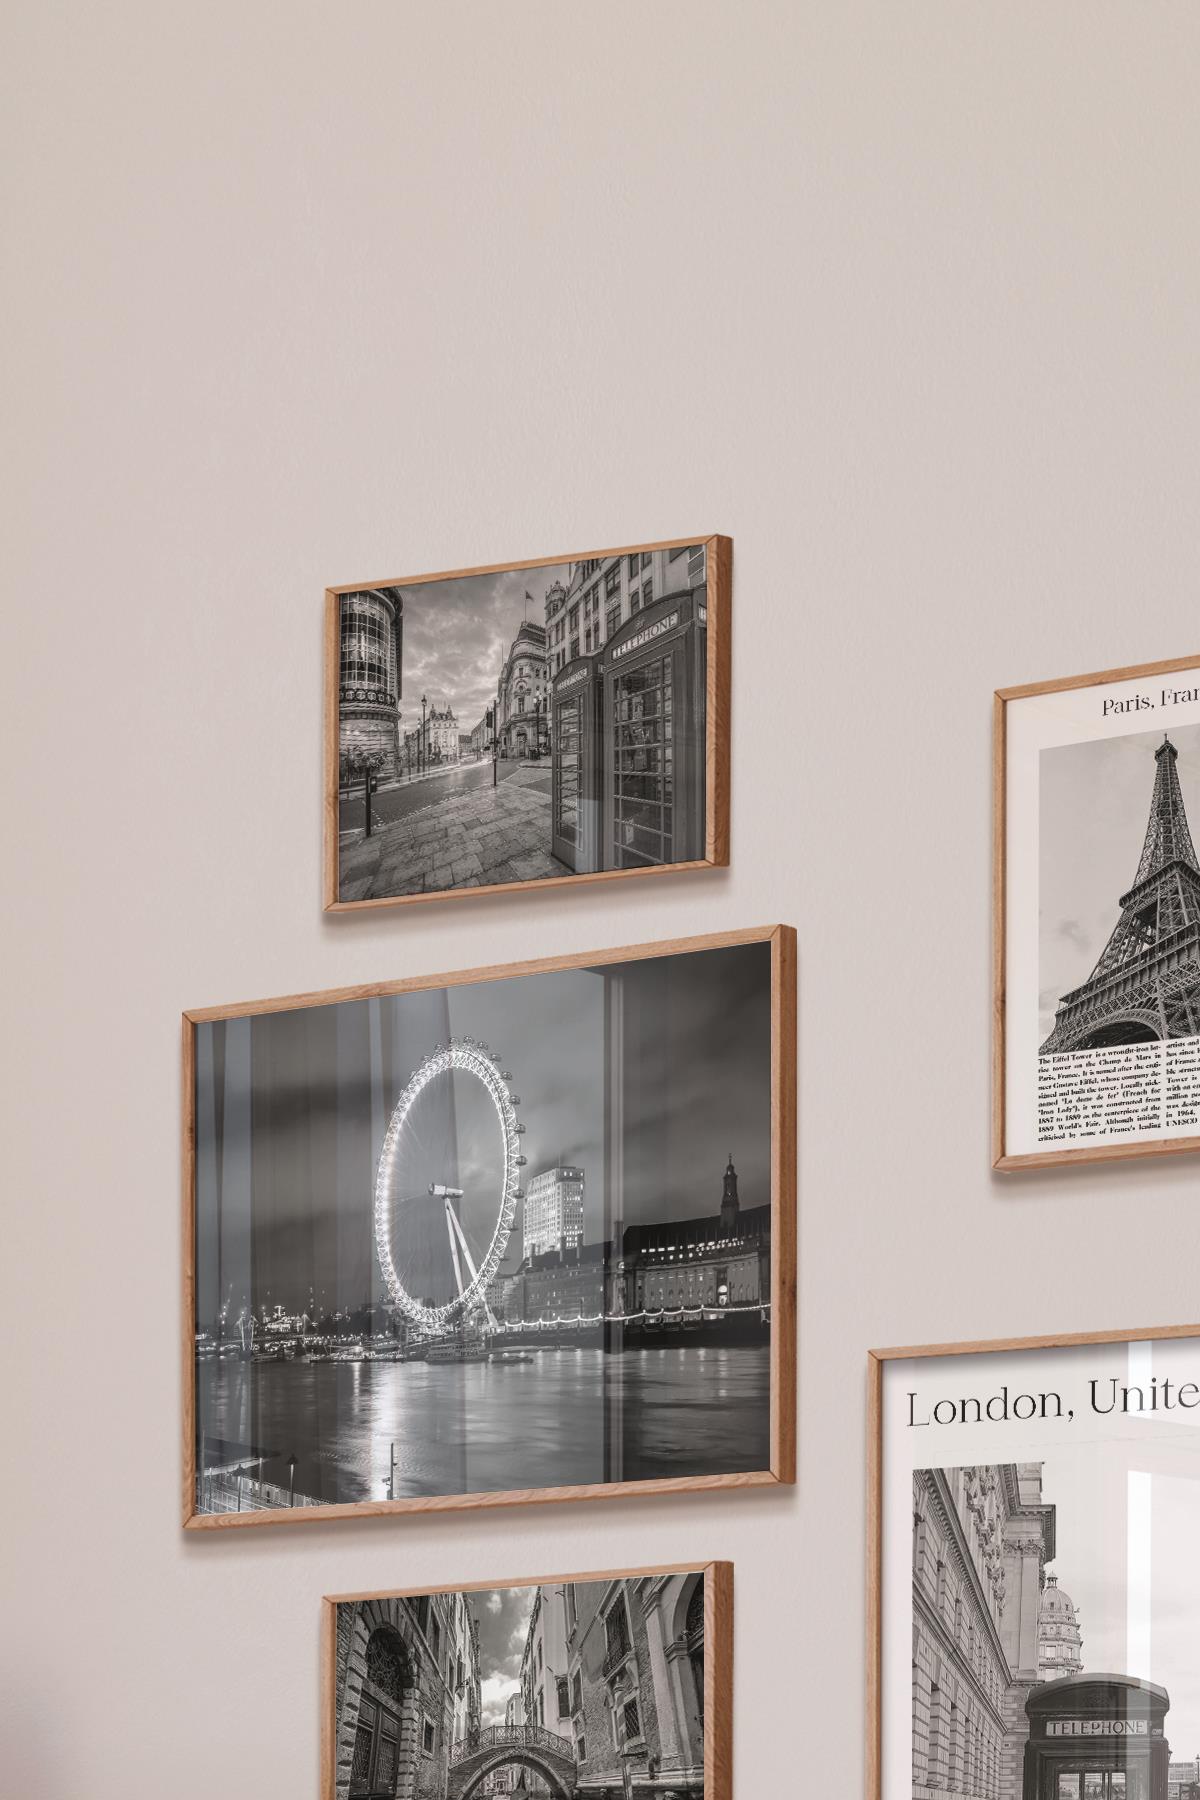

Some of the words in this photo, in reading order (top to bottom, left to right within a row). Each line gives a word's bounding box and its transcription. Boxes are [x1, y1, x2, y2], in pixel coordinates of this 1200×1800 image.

[1103, 694, 1155, 717] Paris,
[907, 1386, 1076, 1427] London,
[1049, 1721, 1145, 1734] TELEPHONE
